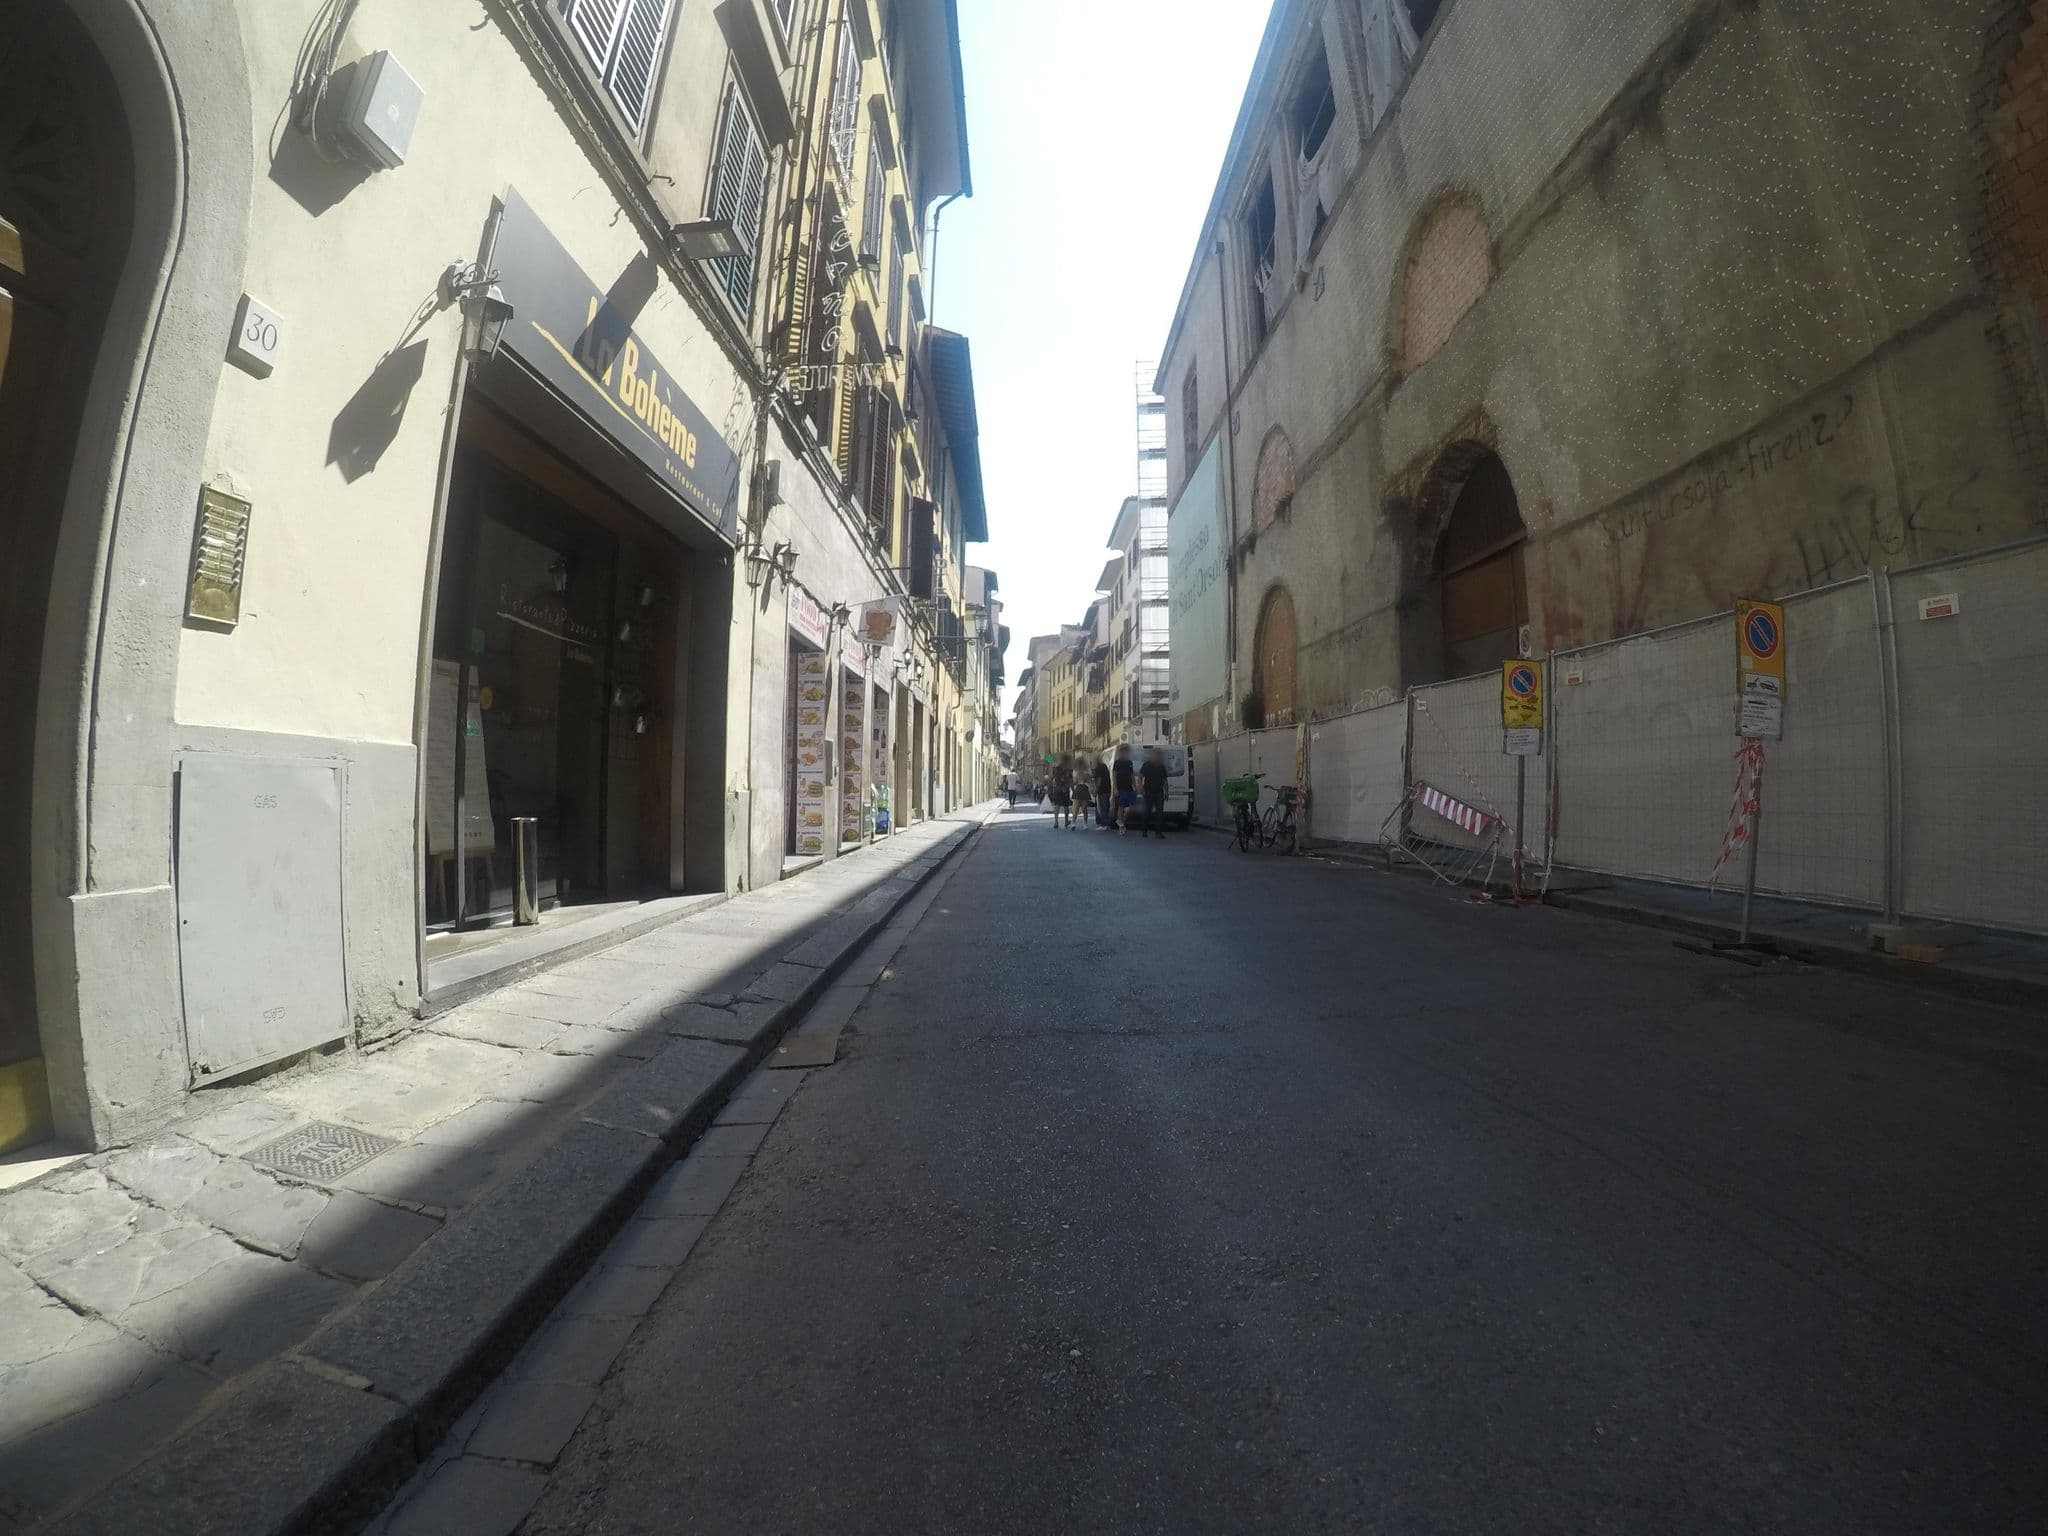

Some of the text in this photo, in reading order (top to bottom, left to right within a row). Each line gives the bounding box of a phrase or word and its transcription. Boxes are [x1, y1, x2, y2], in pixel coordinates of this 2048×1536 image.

[247, 312, 277, 351] 30
[583, 296, 697, 469] La Bohème
[254, 795, 279, 809] GAS
